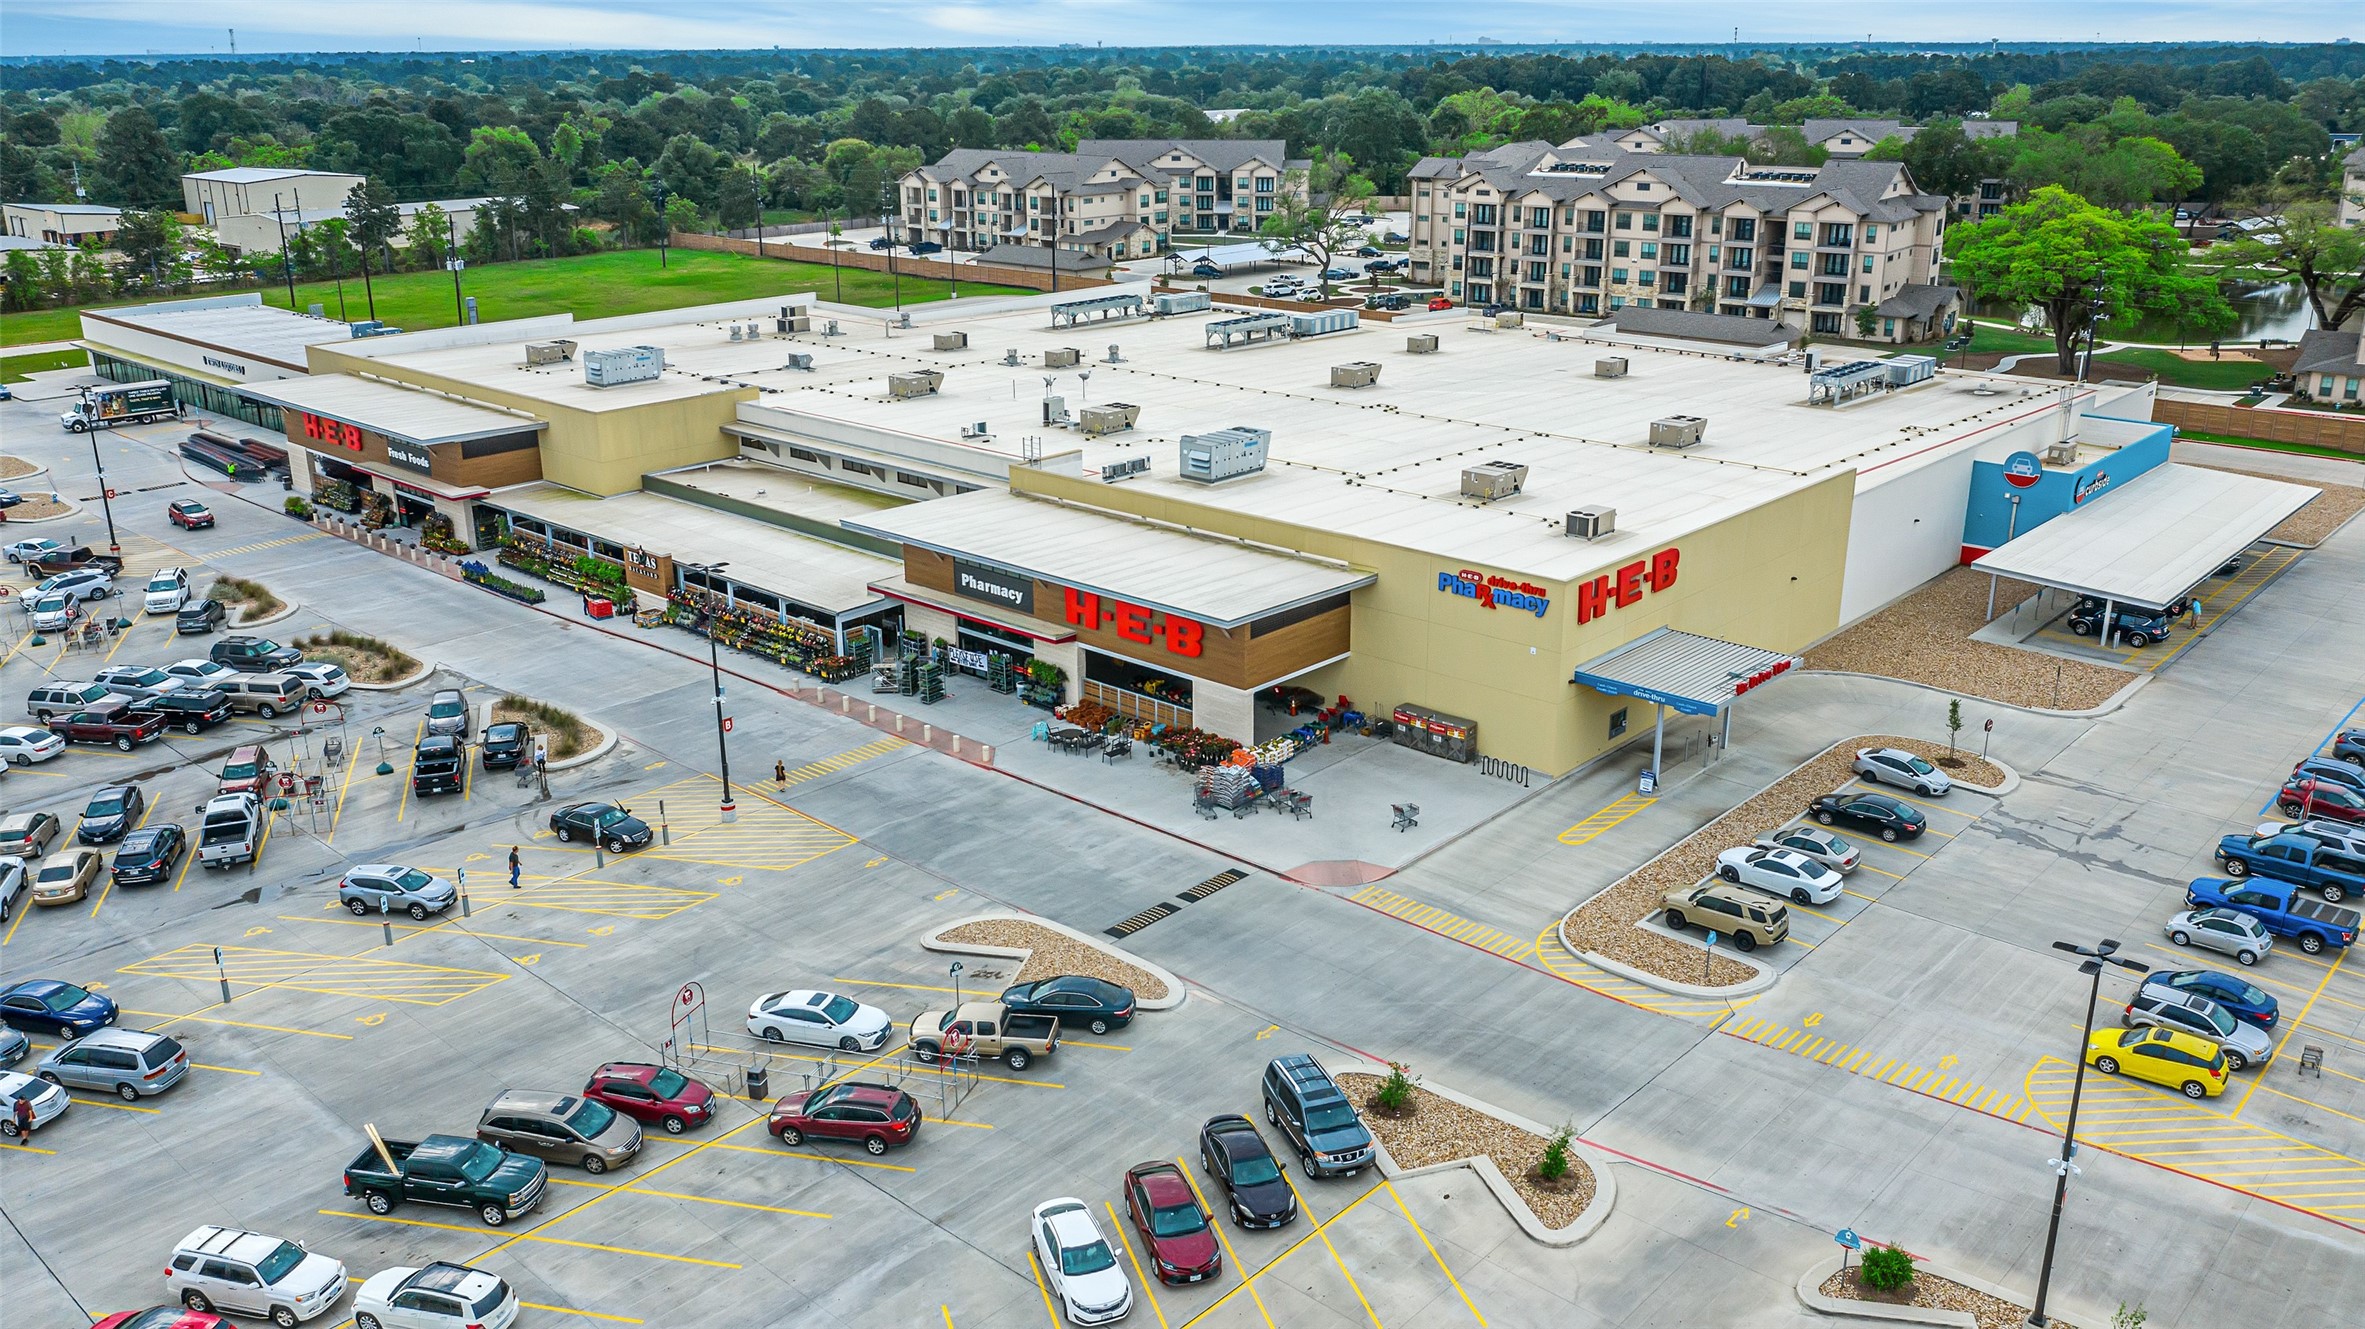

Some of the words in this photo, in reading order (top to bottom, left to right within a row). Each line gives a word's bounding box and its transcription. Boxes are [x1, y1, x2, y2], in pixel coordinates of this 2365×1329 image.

[387, 446, 407, 462] Fresh
[408, 452, 430, 468] Foods
[961, 573, 1023, 604] Pharmacy
[1487, 575, 1546, 597] drive-thru
[1633, 689, 1666, 703] drive-thru
[725, 720, 732, 730] B
